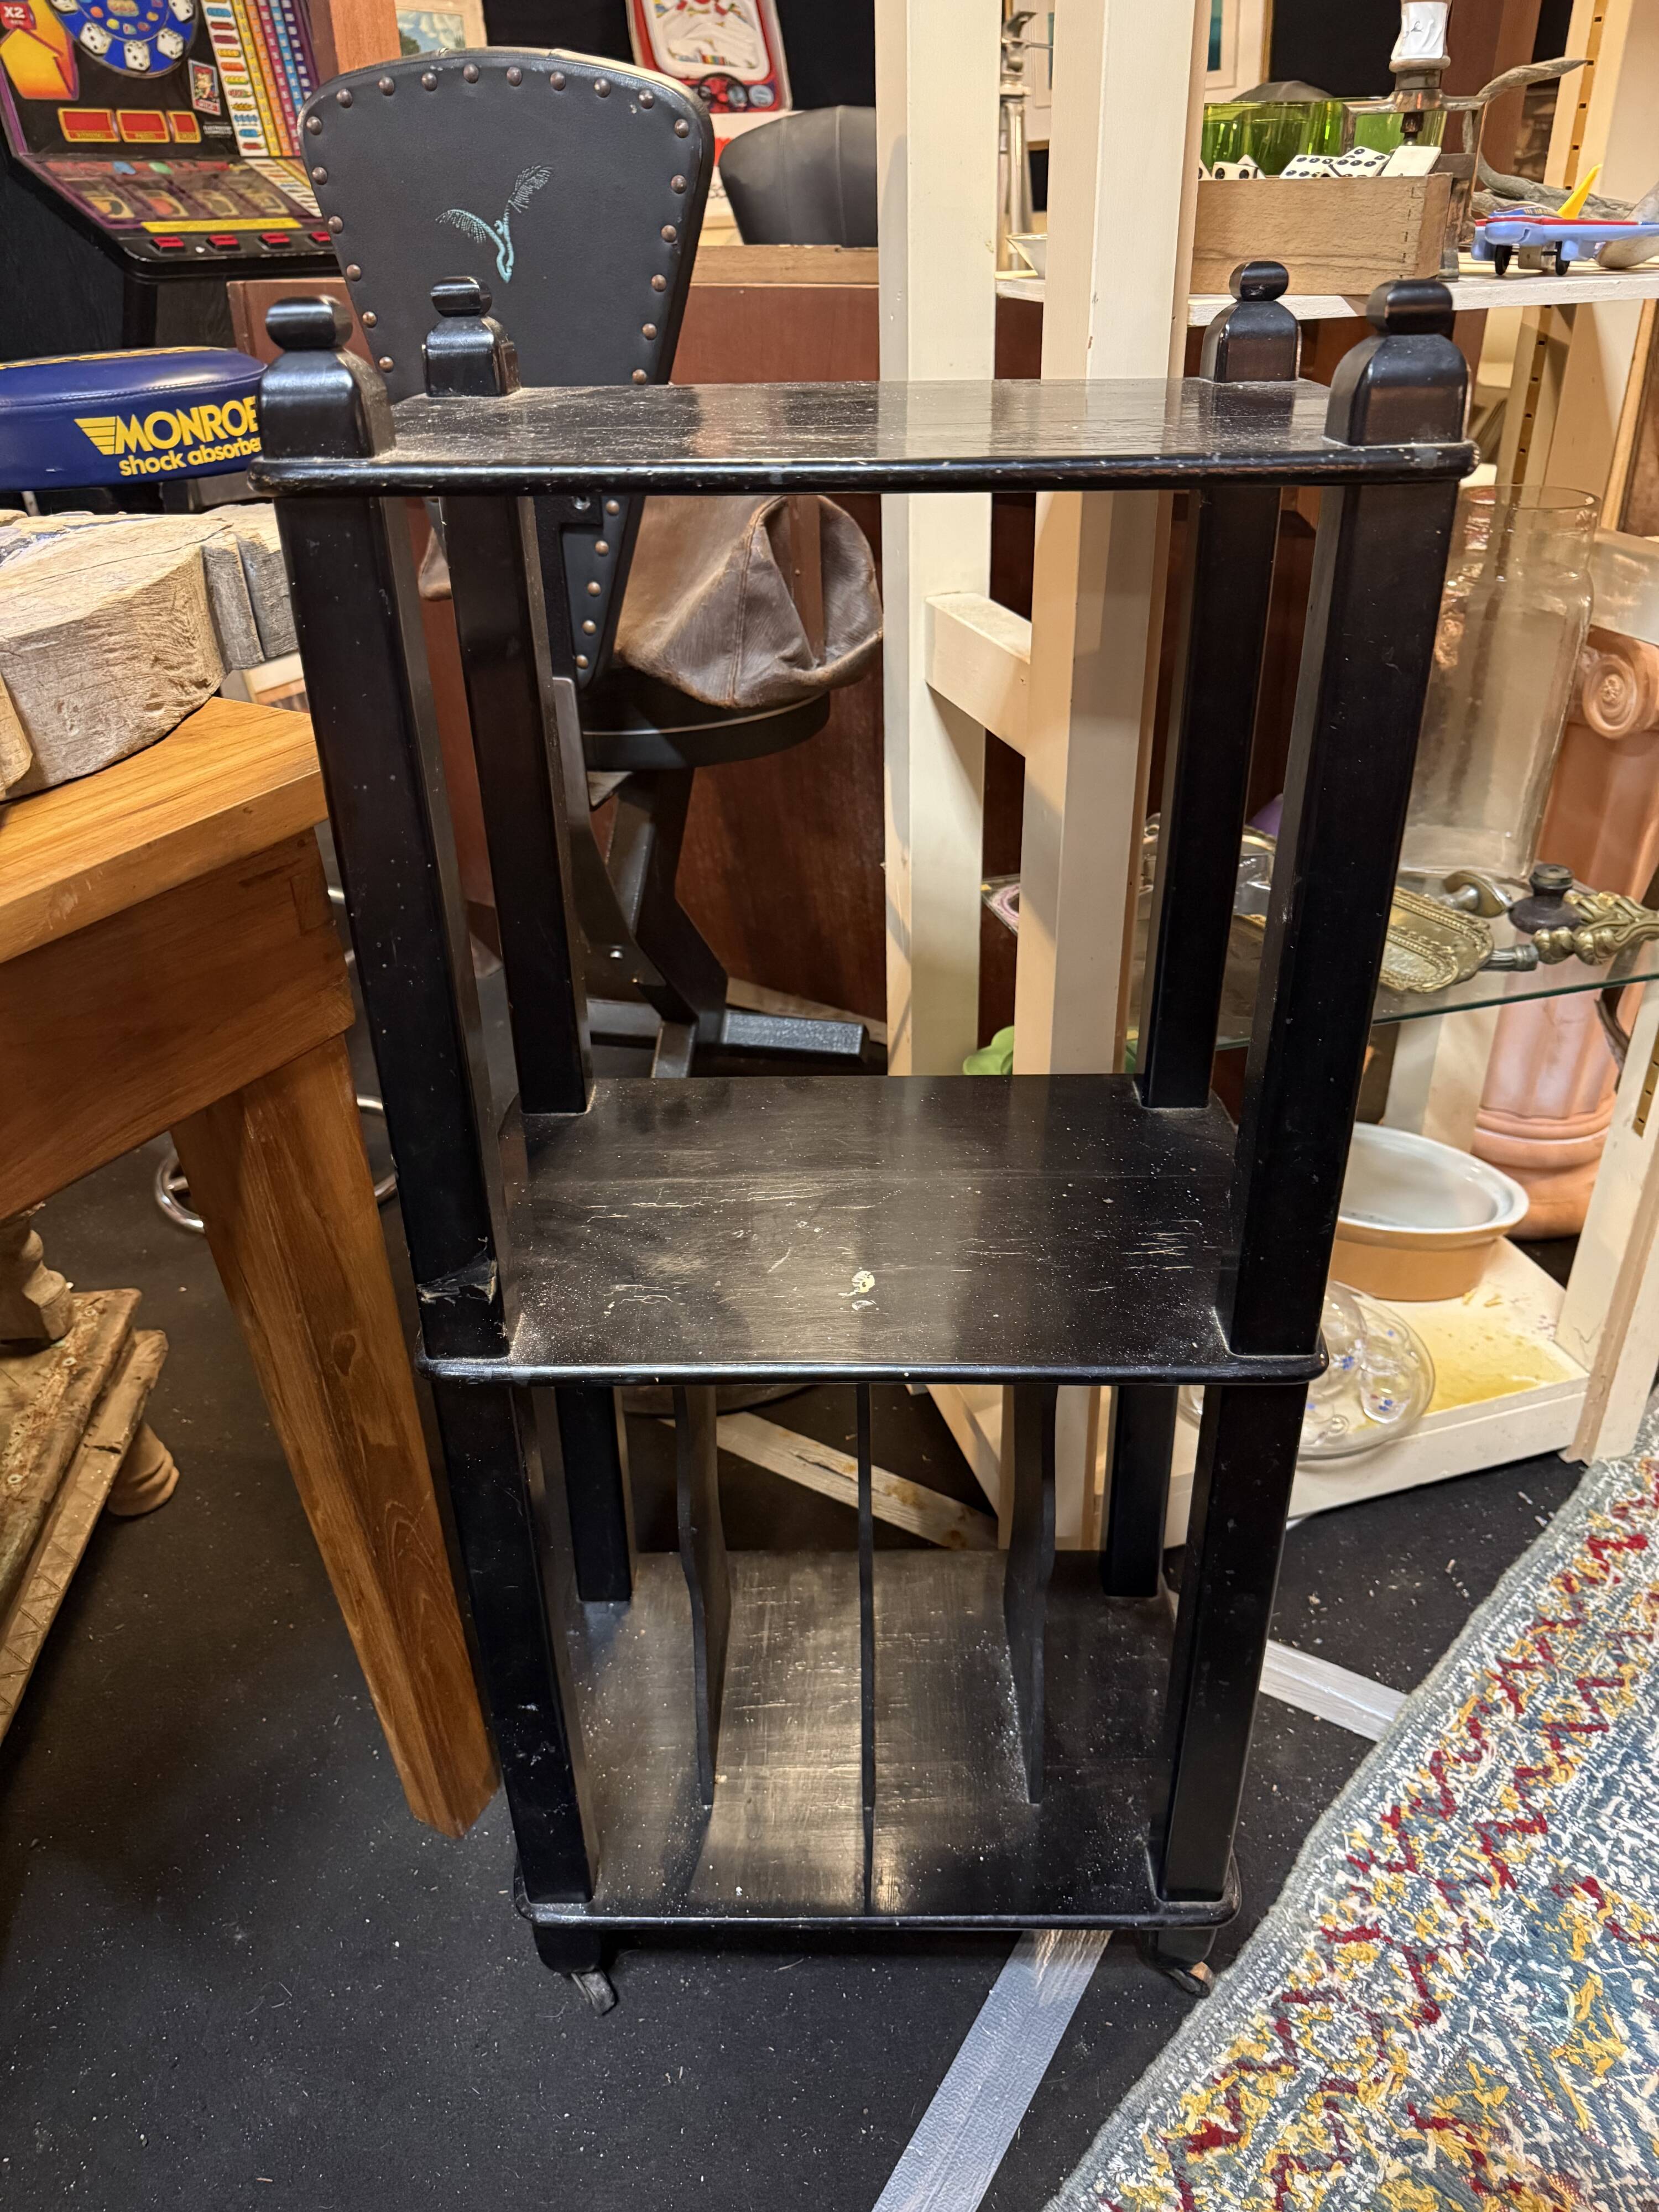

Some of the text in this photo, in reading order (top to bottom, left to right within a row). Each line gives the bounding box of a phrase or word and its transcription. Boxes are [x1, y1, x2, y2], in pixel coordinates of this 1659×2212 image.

[3, 6, 25, 19] X2
[114, 395, 259, 454] MONROE
[118, 450, 187, 476] shock
